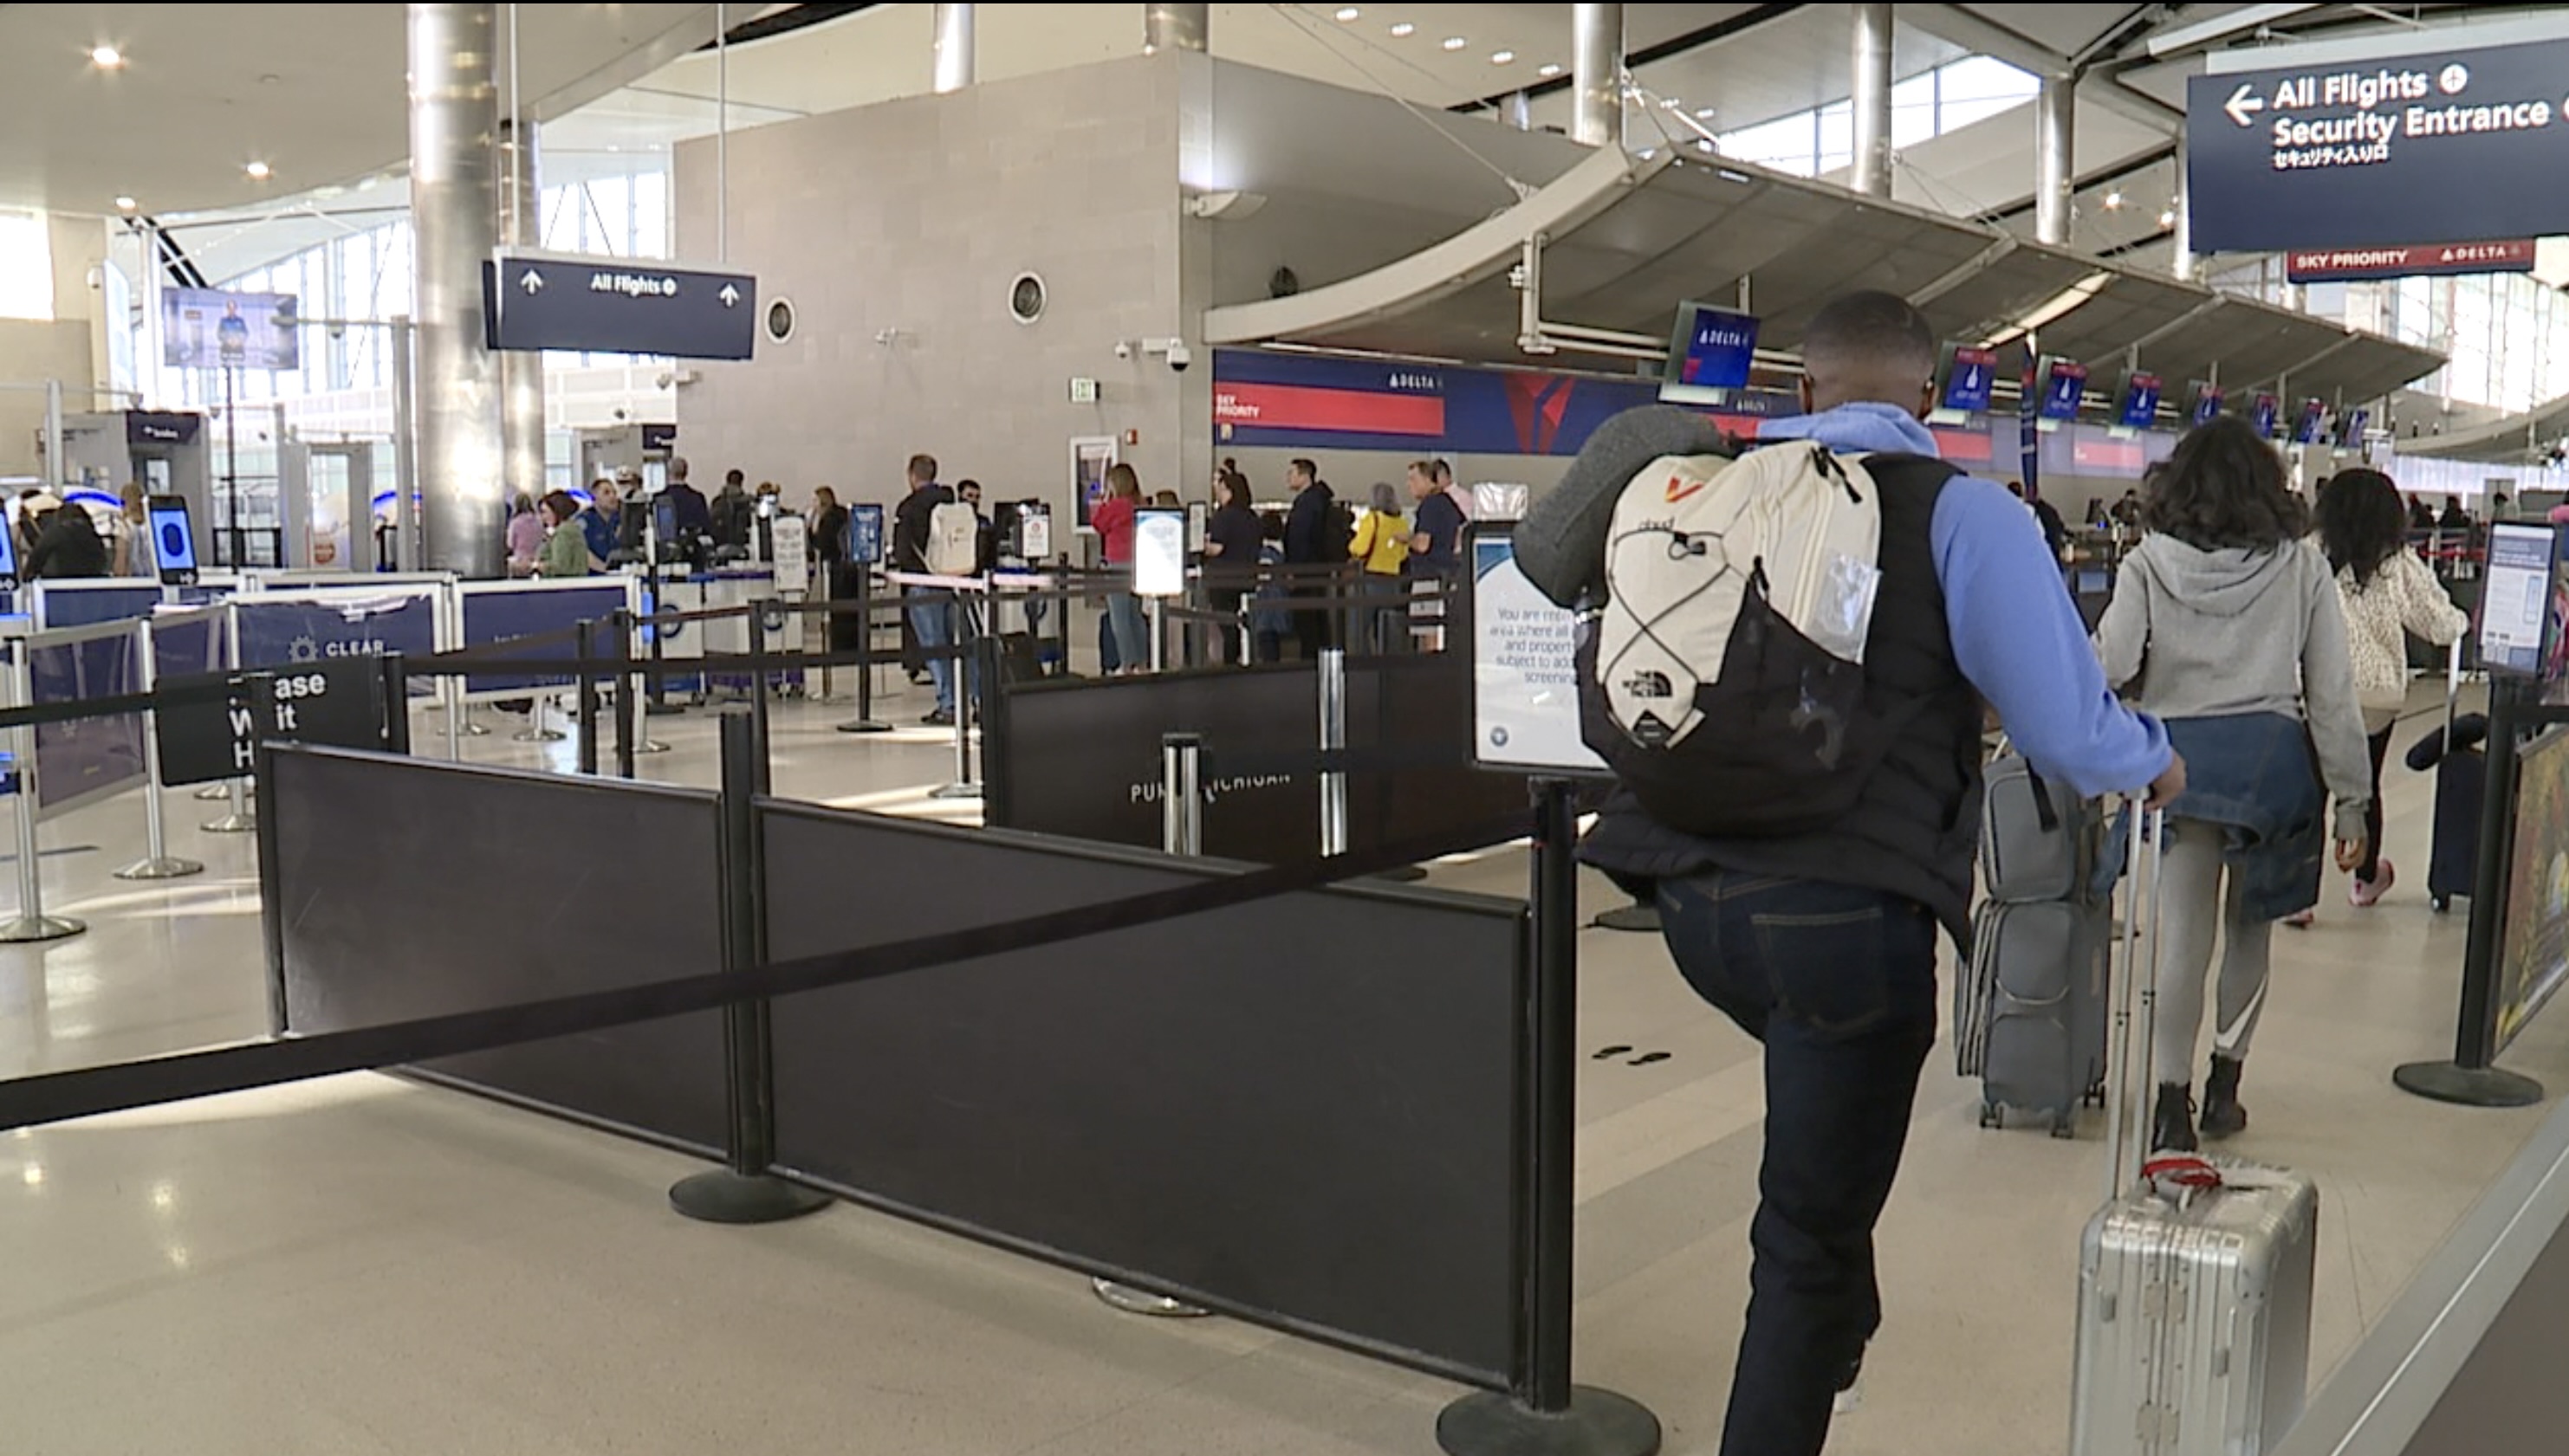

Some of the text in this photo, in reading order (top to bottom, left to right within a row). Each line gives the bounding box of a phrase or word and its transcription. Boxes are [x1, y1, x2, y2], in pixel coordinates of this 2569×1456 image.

[2273, 68, 2429, 109] All Flights
[2274, 100, 2550, 147] Security Entrance
[2274, 144, 2390, 169] セキュリティ入り口
[2297, 250, 2408, 269] SKY PRIORITY
[2456, 246, 2507, 259] DELTA
[591, 273, 660, 297] All Flights
[1399, 372, 1435, 390] DELTA
[1498, 608, 1520, 620] You
[326, 639, 385, 657] CLEAR
[1528, 642, 1572, 654] propert
[275, 673, 327, 699] ase
